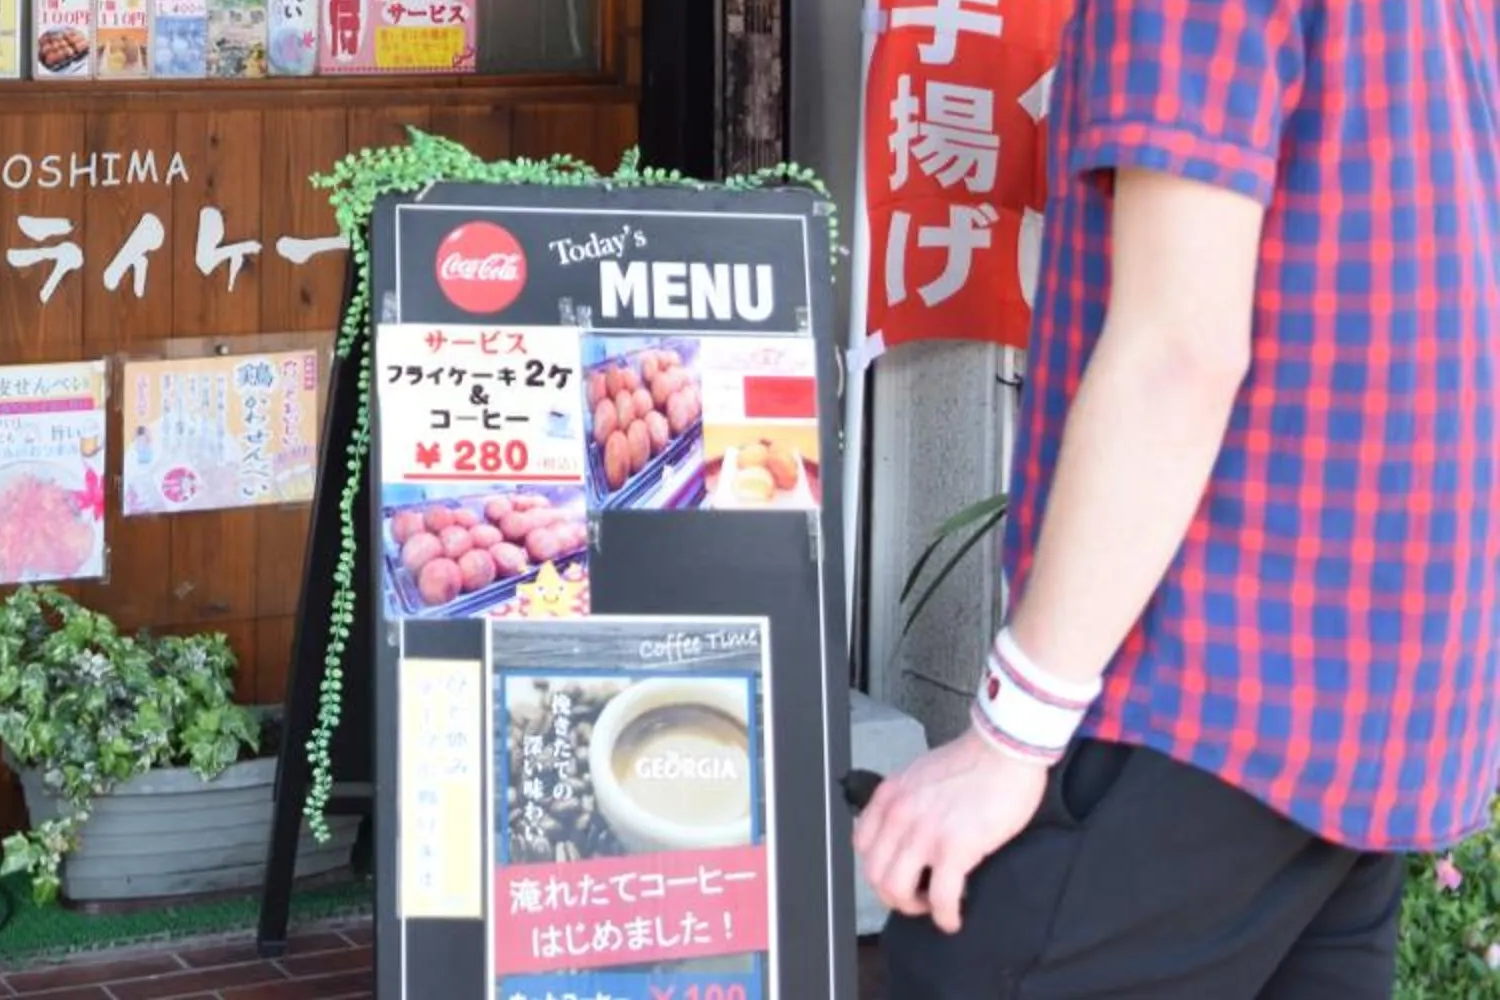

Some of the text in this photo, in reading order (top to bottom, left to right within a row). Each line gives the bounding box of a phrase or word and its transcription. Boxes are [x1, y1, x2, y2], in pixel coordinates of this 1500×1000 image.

[387, 3, 466, 24] サービス
[549, 224, 648, 267] Today's
[440, 251, 521, 283] Coca-Cola
[599, 260, 774, 321] MENU
[424, 330, 529, 355] サービス
[468, 384, 490, 405] &
[429, 409, 530, 431] コーヒー
[639, 628, 758, 663] Coffee Time
[551, 694, 573, 801] 挽きたての
[635, 751, 738, 780] GEORGIA
[523, 735, 545, 843] 深い味わい
[508, 867, 757, 914] 淹れたてコーヒー
[531, 913, 735, 958] はじめました！
